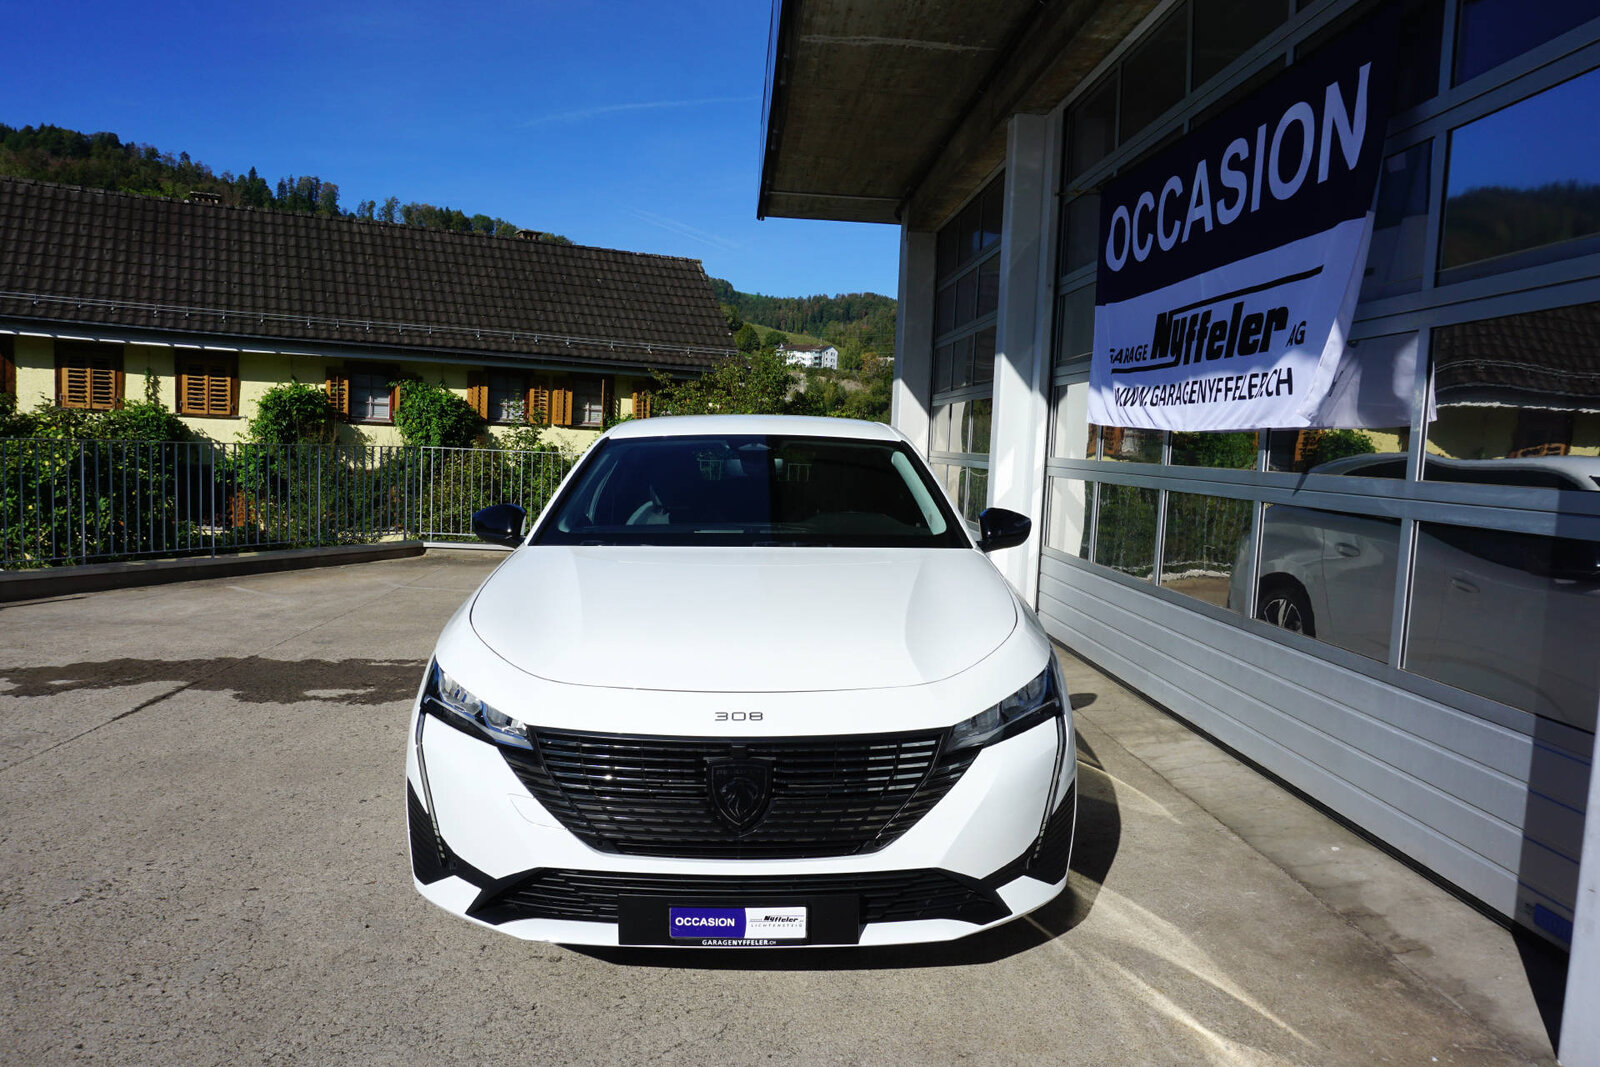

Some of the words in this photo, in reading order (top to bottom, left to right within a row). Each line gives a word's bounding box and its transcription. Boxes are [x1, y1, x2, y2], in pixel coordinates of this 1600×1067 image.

[1105, 61, 1372, 272] OCCASION
[1150, 301, 1289, 366] Nyffeler
[1285, 320, 1307, 348] AG
[715, 712, 763, 721] 308
[675, 917, 735, 927] OCCASION
[763, 915, 799, 923] Nyffeler
